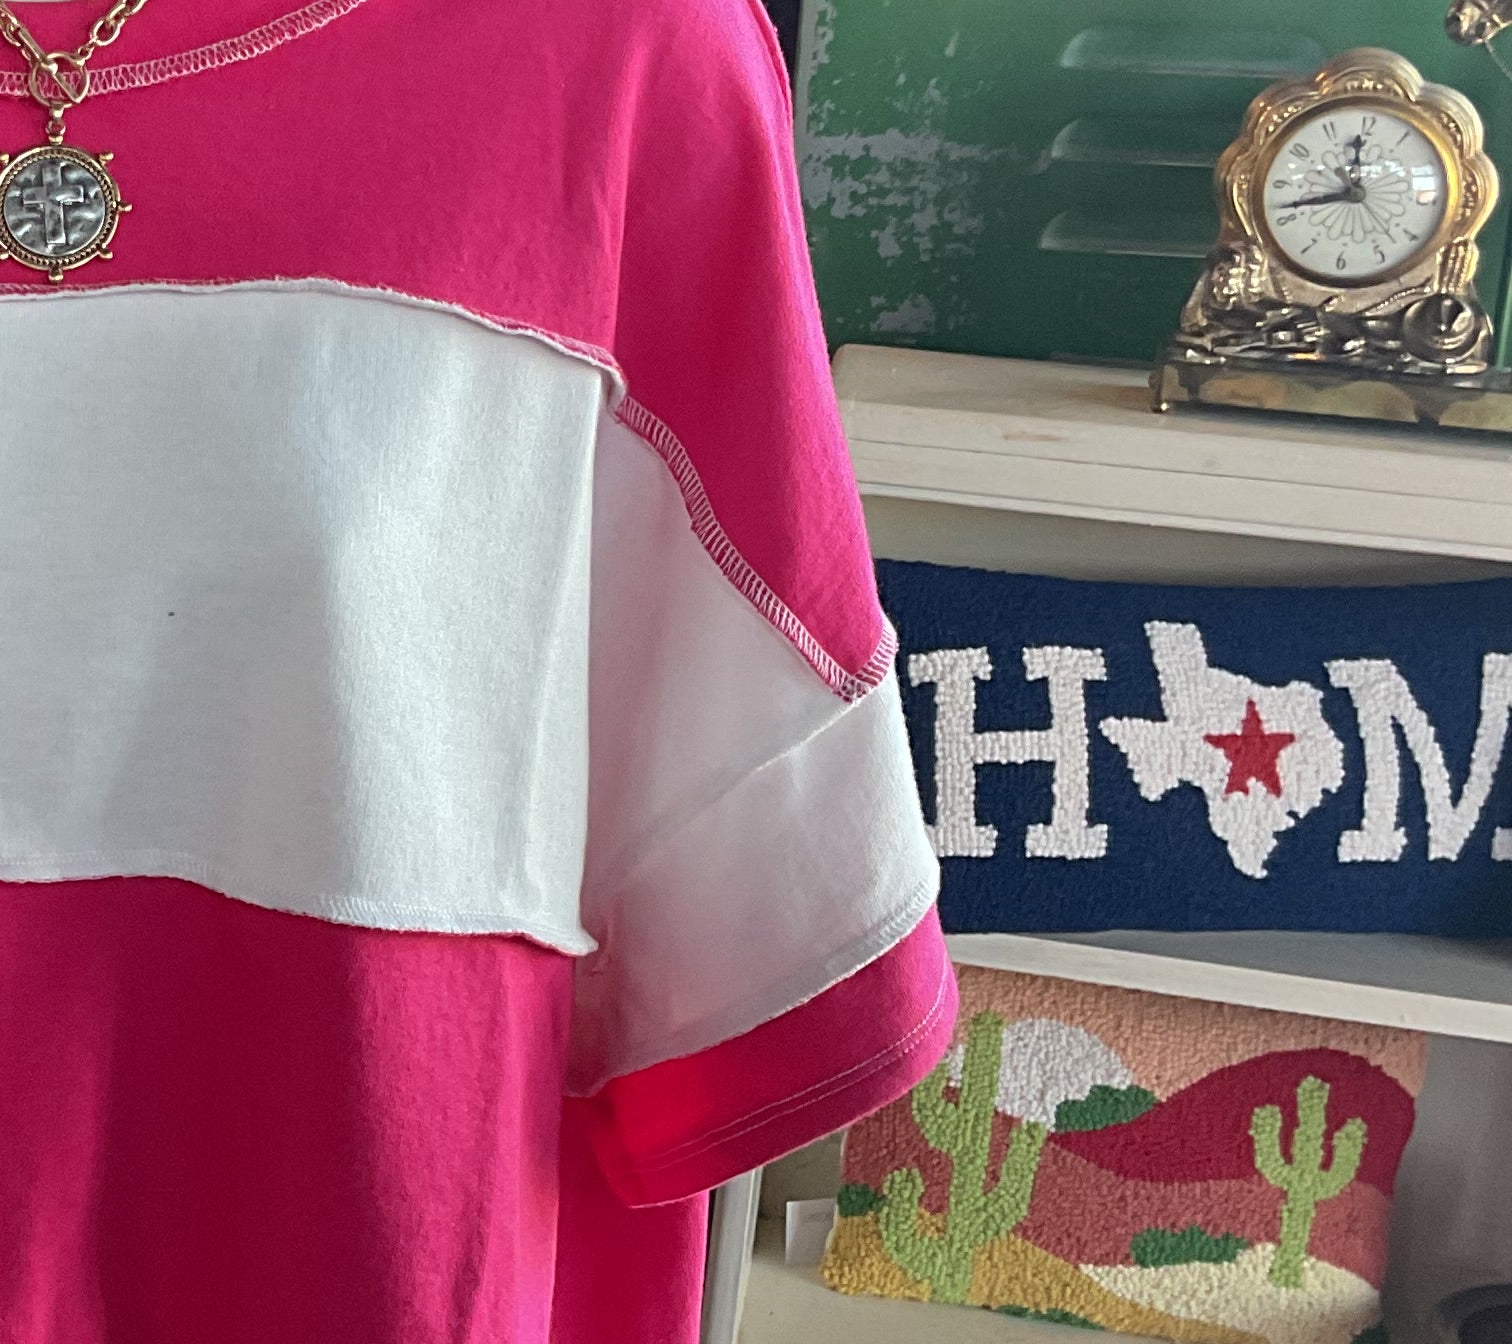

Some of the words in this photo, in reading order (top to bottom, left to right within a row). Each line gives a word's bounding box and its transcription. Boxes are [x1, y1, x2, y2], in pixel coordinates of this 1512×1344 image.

[1361, 116, 1376, 136] 12
[1336, 251, 1347, 270] 6
[1373, 244, 1385, 264] 5
